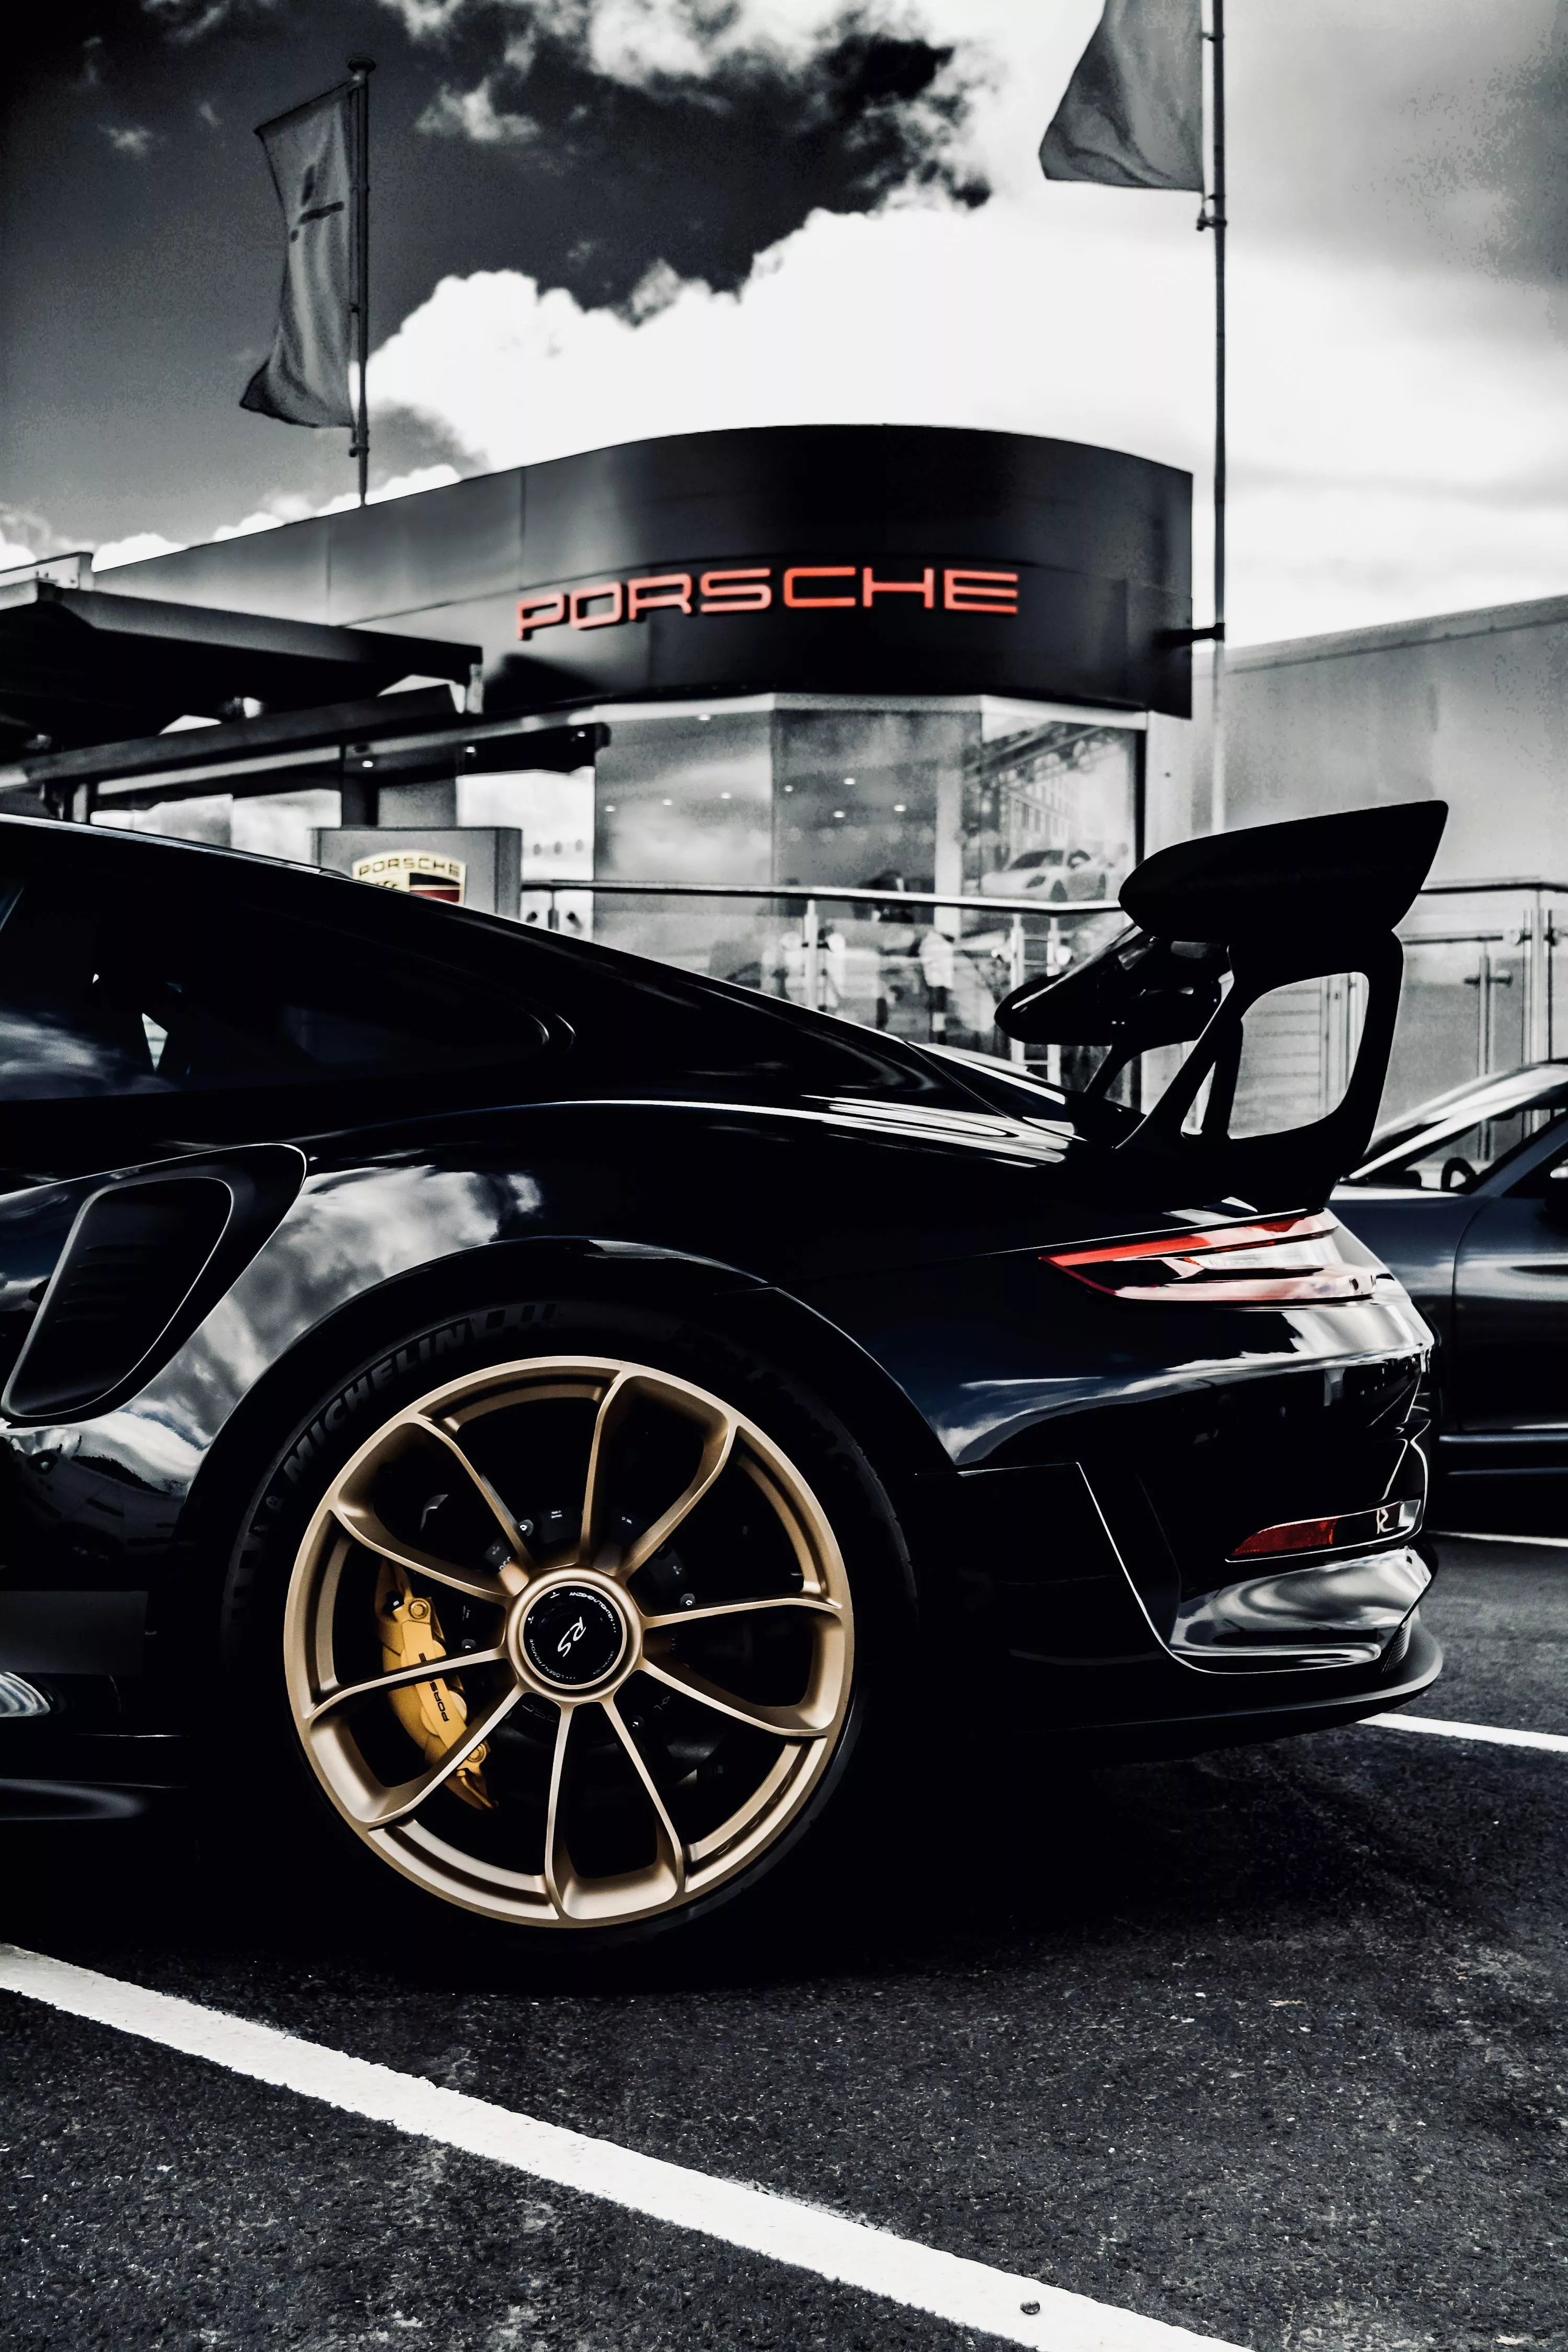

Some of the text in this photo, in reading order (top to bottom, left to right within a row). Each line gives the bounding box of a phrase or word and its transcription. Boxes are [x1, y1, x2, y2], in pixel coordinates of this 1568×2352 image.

[515, 566, 1018, 640] PORSCHE
[359, 857, 460, 877] PORSCHE
[283, 1323, 466, 1483] MICHELIN
